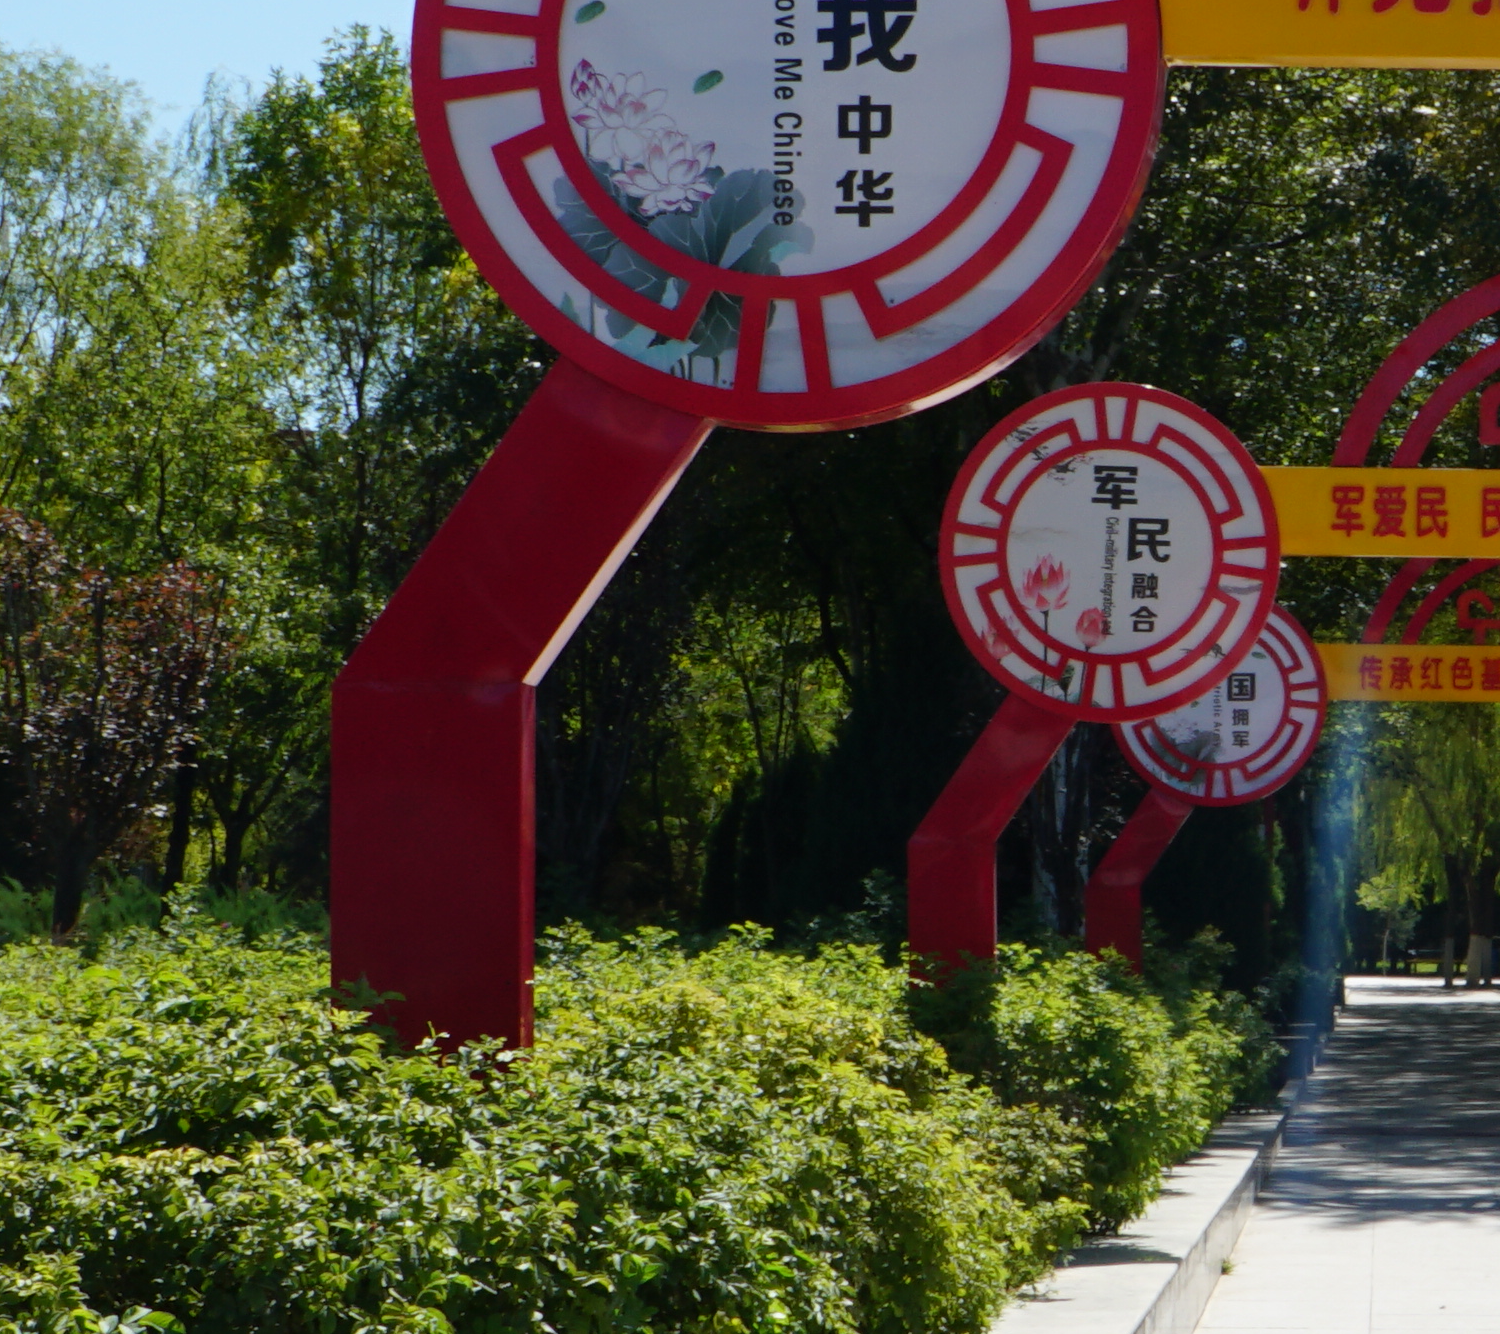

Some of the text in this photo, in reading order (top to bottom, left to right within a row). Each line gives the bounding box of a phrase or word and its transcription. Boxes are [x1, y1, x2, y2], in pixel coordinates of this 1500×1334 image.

[773, 58, 802, 100] Me
[772, 112, 803, 226] Chinese
[1091, 465, 1171, 633] 军民融合
[1330, 485, 1448, 538] 军爱民
[1227, 673, 1256, 748] 国拥军
